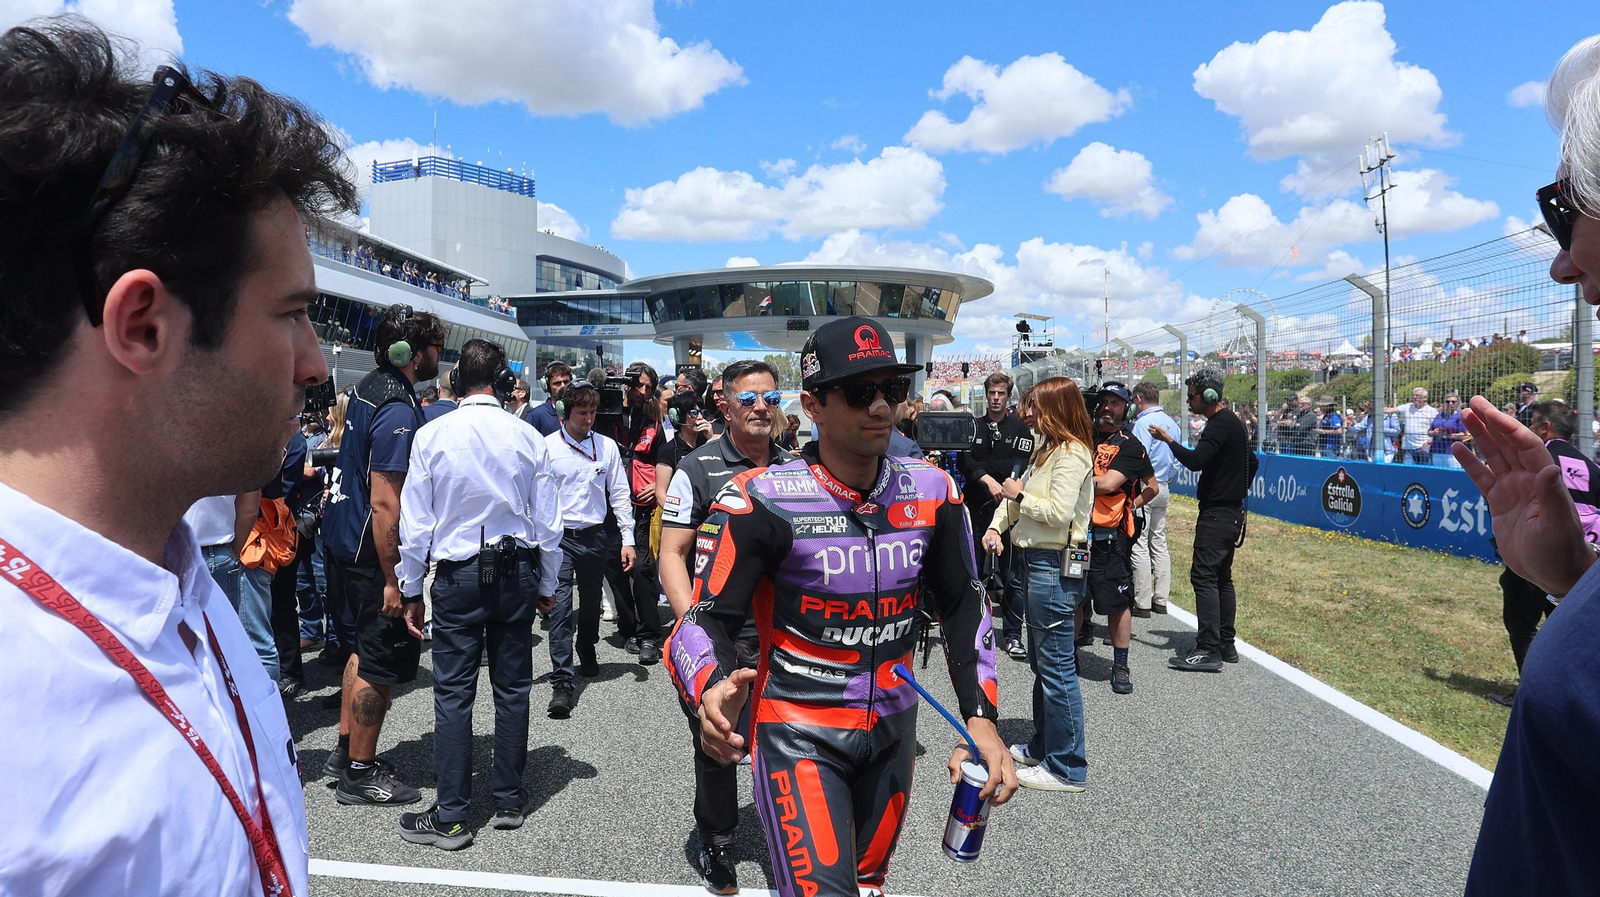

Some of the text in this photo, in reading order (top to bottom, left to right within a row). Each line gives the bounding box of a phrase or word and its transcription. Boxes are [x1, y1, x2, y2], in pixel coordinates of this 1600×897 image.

[848, 350, 891, 361] PRAMAC
[772, 480, 820, 492] FIAMM
[814, 467, 857, 501] PRAMAC
[1278, 475, 1296, 503] 0,0
[1327, 482, 1355, 499] Estrella
[895, 493, 925, 501] PRAMAC
[1327, 496, 1353, 513] Galicia
[812, 525, 848, 533] HELMET
[825, 516, 847, 526] R10
[696, 537, 715, 551] OTUL
[814, 538, 924, 586] prima
[821, 617, 914, 646] DUCATI
[769, 769, 819, 897] PRAMA
